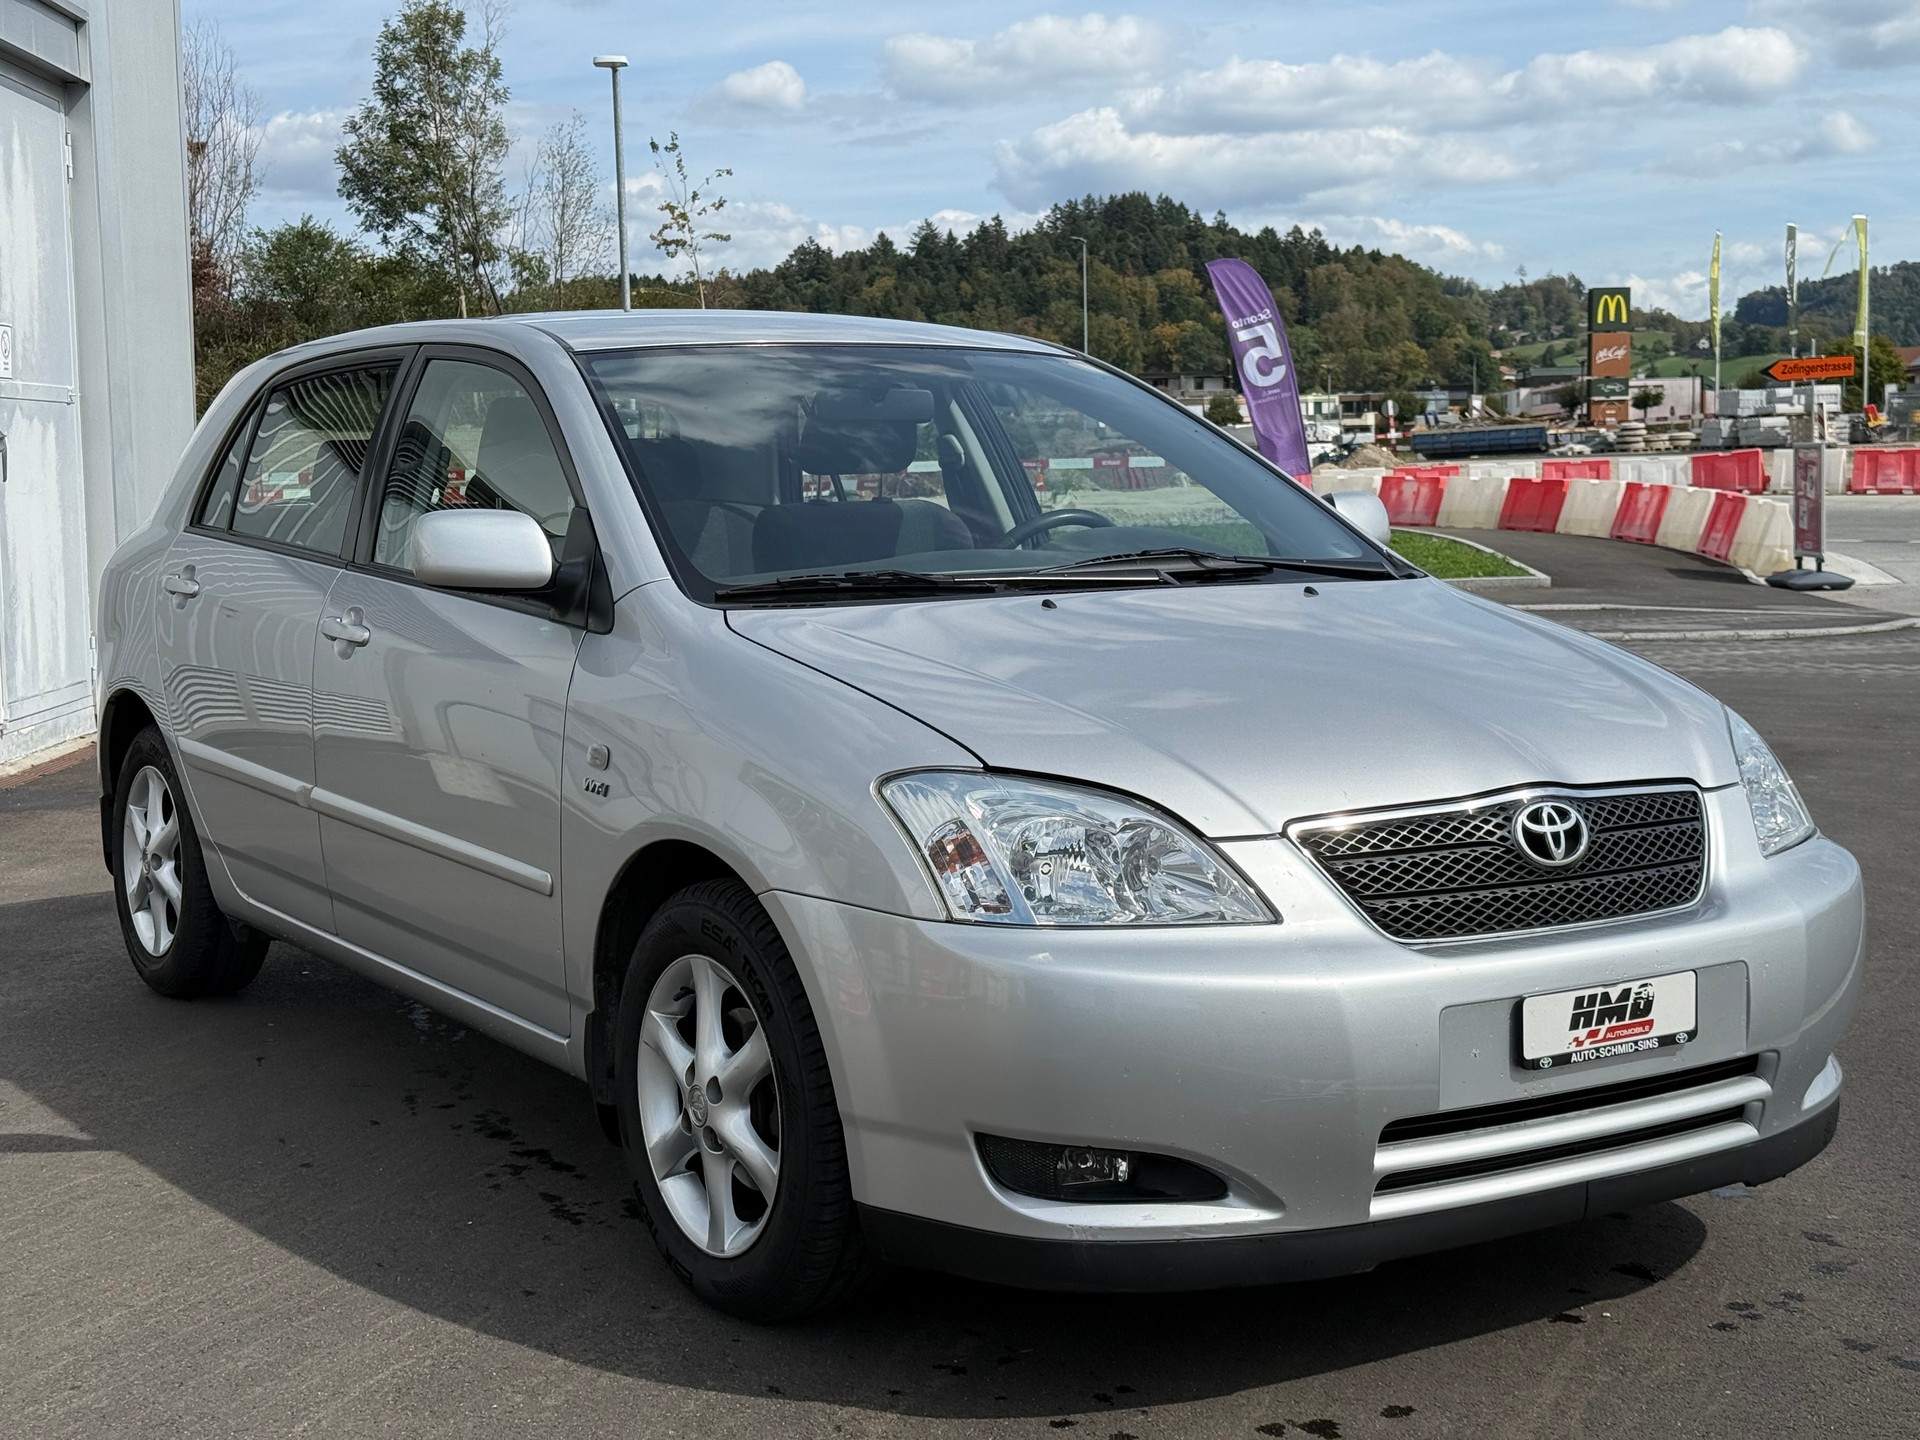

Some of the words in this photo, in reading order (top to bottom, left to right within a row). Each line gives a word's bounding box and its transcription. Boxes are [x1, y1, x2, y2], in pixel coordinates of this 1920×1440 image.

[1780, 361, 1853, 376] Zofingerstrasse
[743, 954, 774, 1021] TECAR
[1605, 1025, 1650, 1040] AUTOMOBILE
[1571, 1038, 1659, 1063] AUTO-SCHMID-SINS
